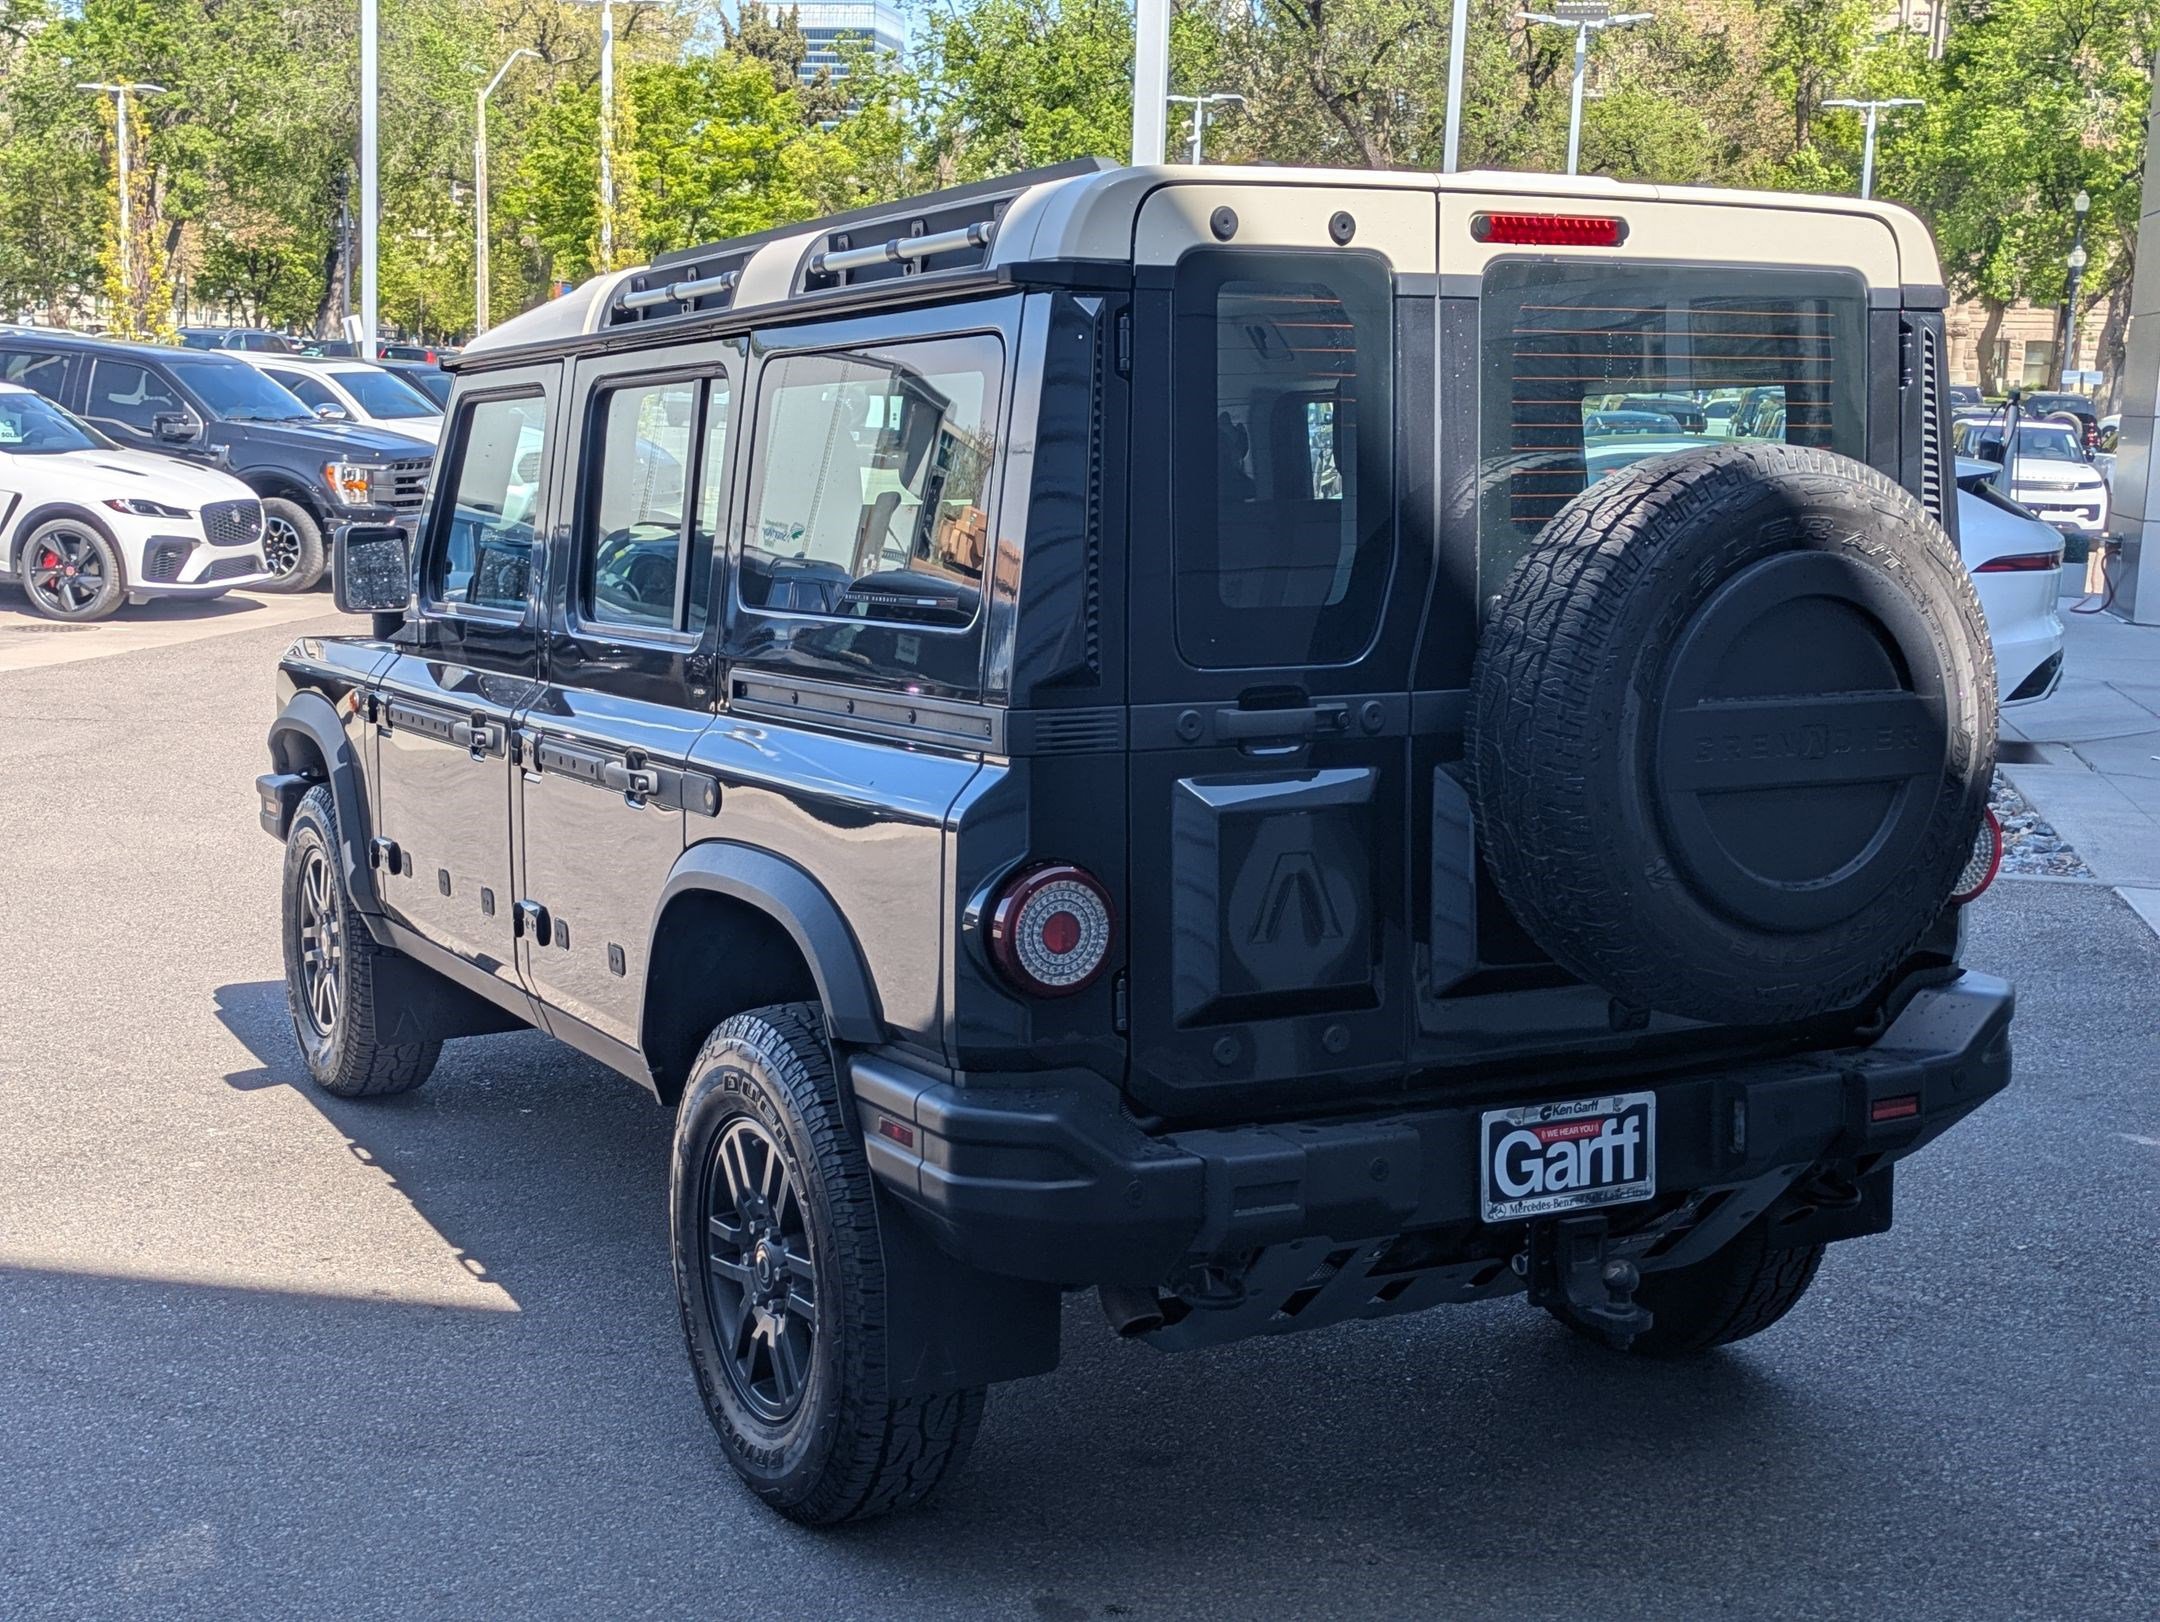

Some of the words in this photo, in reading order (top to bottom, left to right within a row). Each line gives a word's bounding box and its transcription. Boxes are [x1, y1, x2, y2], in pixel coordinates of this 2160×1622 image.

[1552, 1103, 1573, 1117] Ken
[1573, 1100, 1599, 1114] Garff
[1546, 1128, 1559, 1138] WE
[1559, 1126, 1579, 1136] HEAR
[1579, 1124, 1594, 1133] YOU
[1494, 1115, 1640, 1198] Garff
